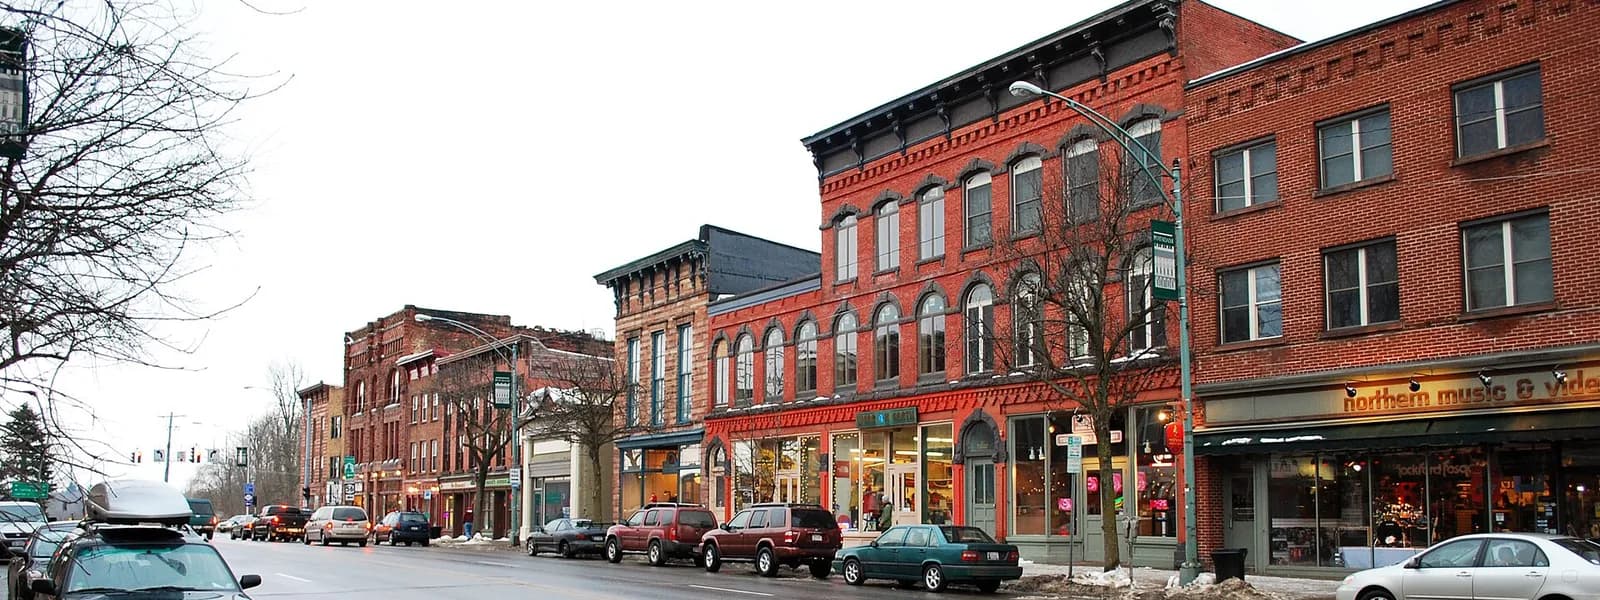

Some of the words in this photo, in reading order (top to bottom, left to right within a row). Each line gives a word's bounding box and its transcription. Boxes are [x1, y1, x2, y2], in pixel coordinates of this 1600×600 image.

[1343, 387, 1430, 412] northern
[1437, 384, 1506, 405] music
[1516, 378, 1534, 400] &
